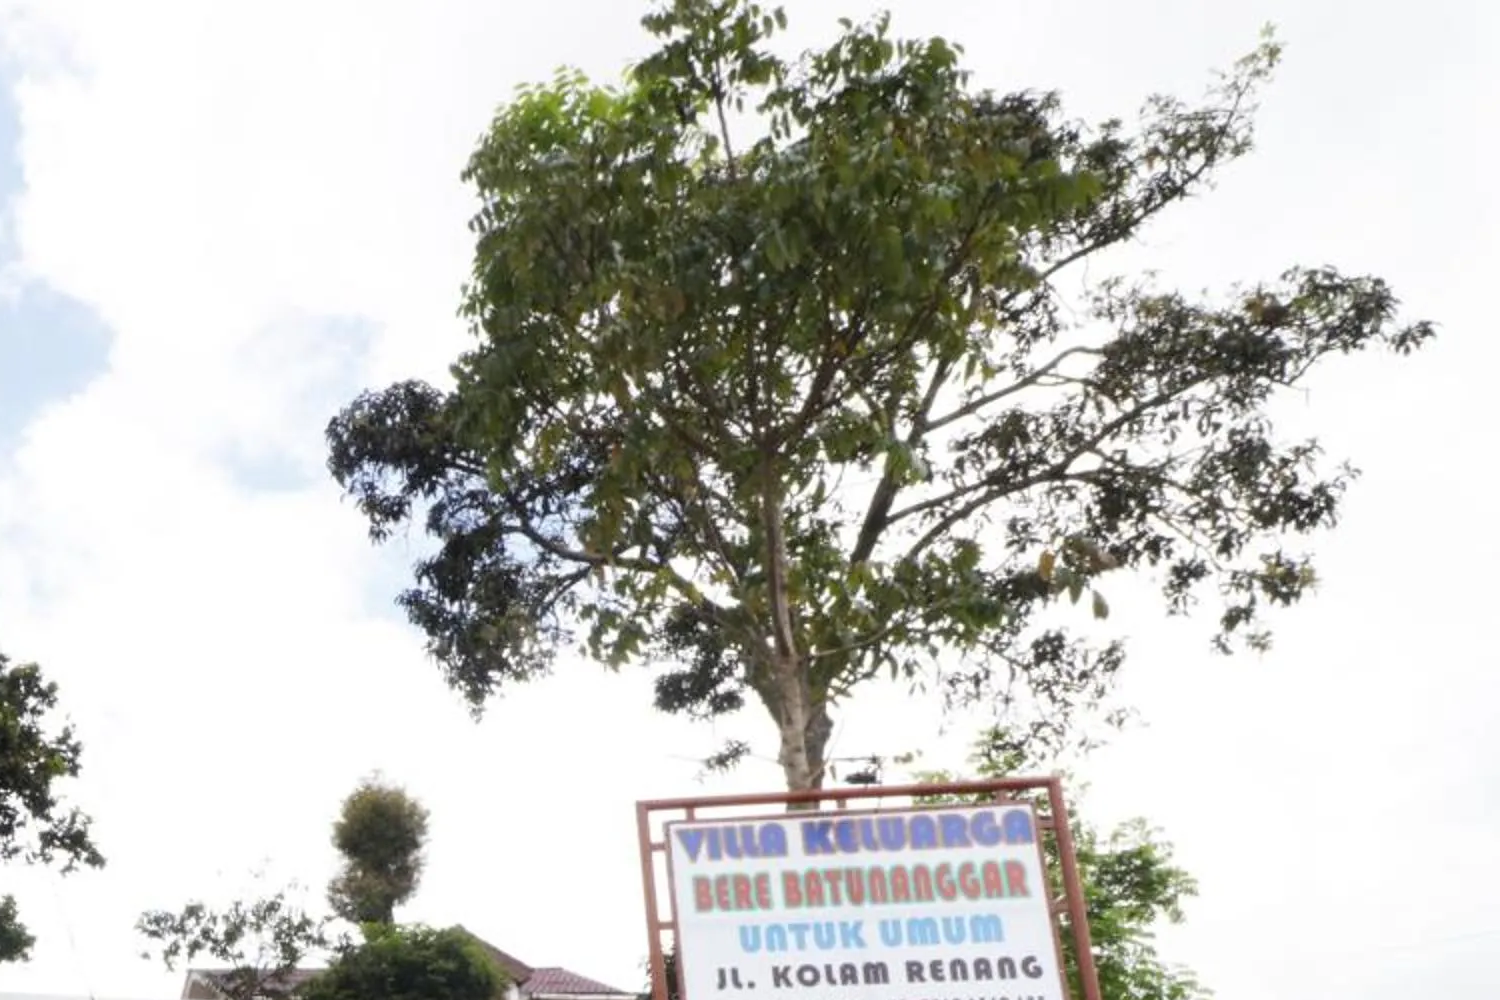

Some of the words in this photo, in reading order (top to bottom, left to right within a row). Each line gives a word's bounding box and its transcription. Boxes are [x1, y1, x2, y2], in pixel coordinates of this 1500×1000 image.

[677, 822, 789, 864] VILLA
[800, 809, 1034, 857] KELUARGA
[692, 870, 774, 914] BERE
[781, 858, 1032, 911] BATUNANGGAR
[738, 920, 867, 954] UNTUK
[879, 913, 1005, 948] UMUM
[716, 967, 757, 991] JL.
[772, 960, 890, 989] KOLAM
[906, 954, 1044, 982] RENANG
